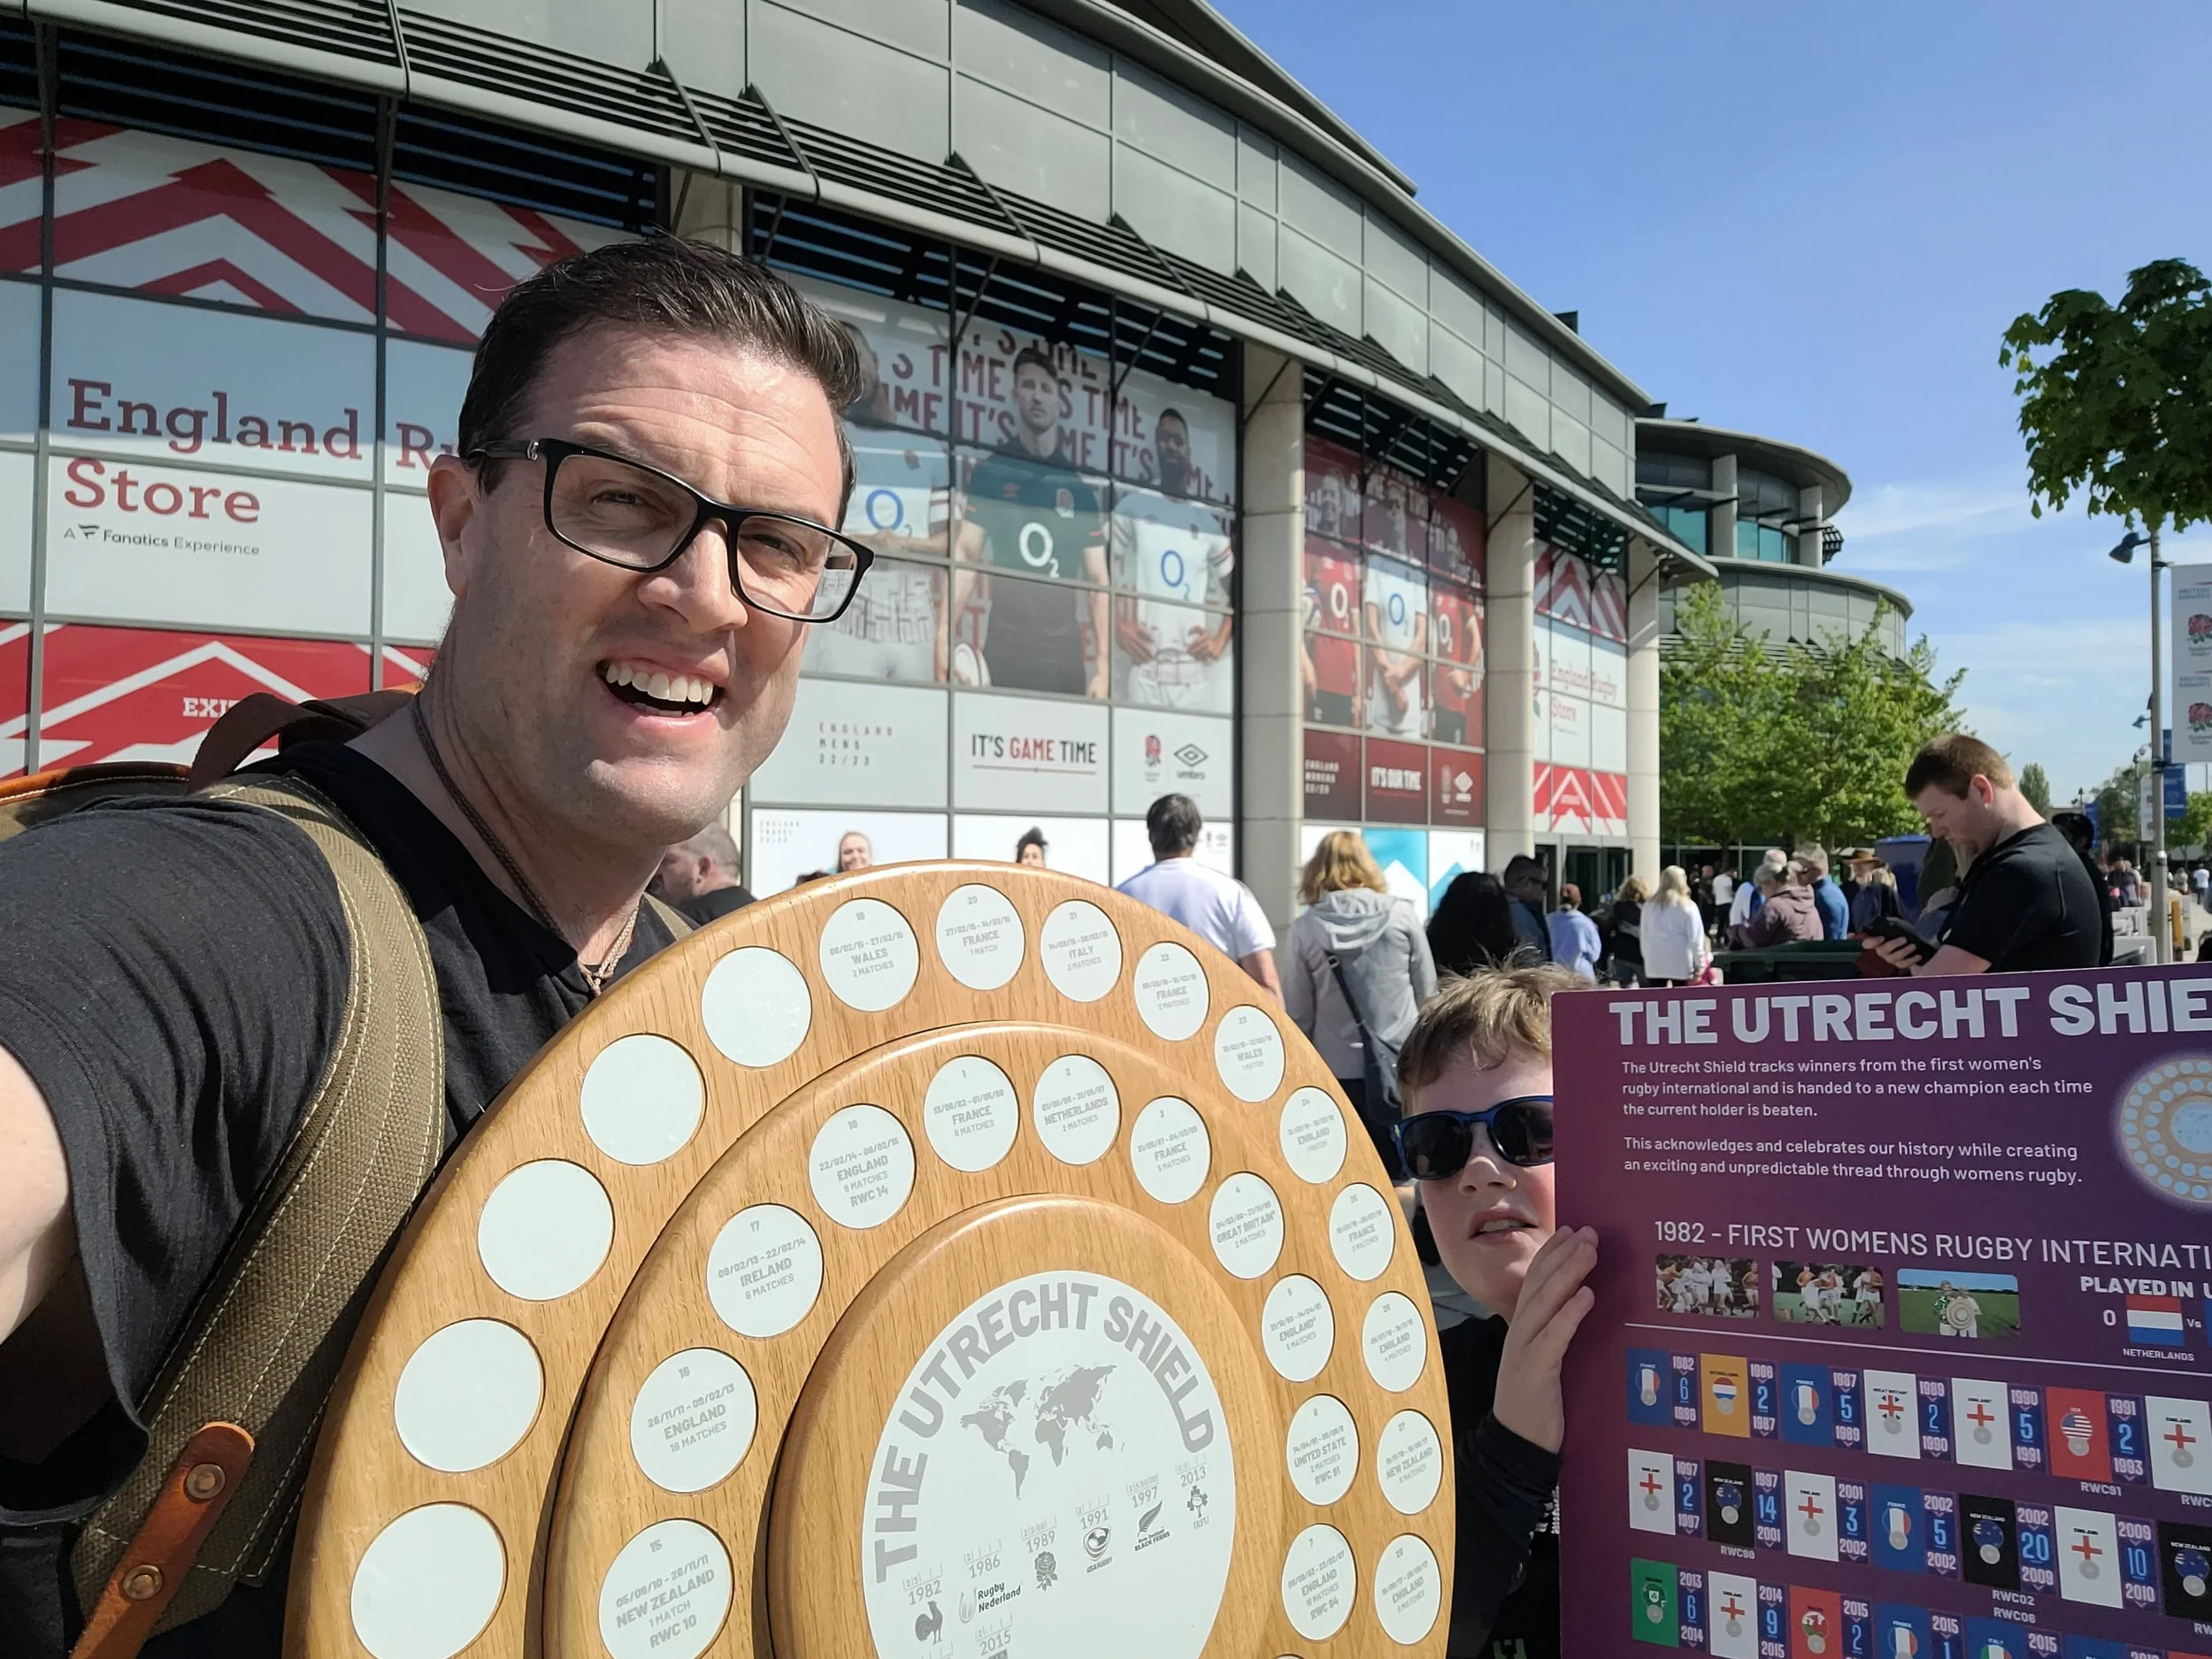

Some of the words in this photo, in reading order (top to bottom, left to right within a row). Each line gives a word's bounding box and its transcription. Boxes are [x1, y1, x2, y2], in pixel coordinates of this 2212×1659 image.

[66, 378, 364, 460] England
[65, 457, 261, 523] Store
[63, 528, 76, 540] A
[103, 529, 169, 548] Fanatics
[173, 536, 260, 556] Experience
[1018, 522, 1060, 579] O2
[972, 733, 1005, 759] IT'S
[1010, 736, 1056, 762] GAME
[1060, 739, 1098, 765] TIME
[963, 930, 1000, 947] FRANCE
[851, 948, 889, 965] WALES
[1068, 944, 1094, 960] ITALY
[1156, 986, 1188, 1001] FRANCE
[1609, 998, 1718, 1045] THE
[1731, 987, 2030, 1044] UTRECHT
[1622, 1062, 1647, 1073] The
[1649, 1061, 1701, 1073] Utrecht
[1702, 1061, 1747, 1073] Shield
[1749, 1060, 1794, 1073] tracks
[1798, 1059, 1856, 1072] winners
[1860, 1058, 1897, 1071] from
[1901, 1058, 1926, 1071] the
[1930, 1057, 1964, 1071] first
[1968, 1056, 2042, 1071] women's
[1623, 1082, 1659, 1097] rugby
[1662, 1081, 1749, 1094] international
[1752, 1081, 1778, 1094] and
[1782, 1081, 1794, 1094] is
[1798, 1081, 1853, 1094] handed
[1855, 1081, 1872, 1094] to
[1875, 1084, 1885, 1094] a
[1888, 1084, 1920, 1094] new
[1924, 1080, 2005, 1097] champion
[2008, 1079, 2050, 1094] each
[2054, 1079, 2093, 1094] time
[952, 1105, 992, 1125] FRANCE
[1044, 1096, 1109, 1125] NETHERLANDS
[1623, 1103, 1645, 1116] the
[1647, 1103, 1697, 1116] current
[1700, 1102, 1745, 1116] holder
[1747, 1103, 1760, 1117] is
[1763, 1103, 1818, 1117] beaten.
[1154, 1141, 1188, 1162] FRANCE
[1624, 1136, 1652, 1150] This
[1654, 1137, 1753, 1154] acknowledges
[1755, 1140, 1783, 1152] and
[1786, 1140, 1866, 1154] celebrates
[1869, 1143, 1895, 1155] our
[1898, 1141, 1955, 1159] history
[1958, 1142, 2002, 1157] while
[2006, 1143, 2078, 1161] creating
[836, 1155, 889, 1181] ENGLAND
[1624, 1160, 1640, 1171] an
[1643, 1159, 1697, 1176] exciting
[1700, 1160, 1725, 1173] and
[1728, 1161, 1830, 1177] unpredictable
[1832, 1164, 1883, 1178] thread
[1886, 1164, 1950, 1182] through
[1953, 1169, 2024, 1182] womens
[2028, 1168, 2084, 1186] rugby.
[850, 1171, 888, 1191] MATCHES
[849, 1190, 876, 1208] RWC
[749, 1220, 761, 1233] 17
[1655, 1220, 1705, 1244] 1982
[1728, 1224, 1800, 1248] FIRST
[1805, 1226, 1929, 1256] WOMENS
[1935, 1233, 2033, 1262] RUGBY
[739, 1257, 793, 1287] IRELAND
[752, 1272, 795, 1298] MATCHES
[2080, 1275, 2170, 1297] PLAYED
[2171, 1280, 2194, 1299] IN
[2186, 1317, 2202, 1329] Vs
[1379, 1332, 1411, 1355] ENGLAND
[2123, 1347, 2195, 1363] NETHERLANDS
[898, 1281, 1099, 1440] UTRECHT
[1103, 1295, 1215, 1454] SHIELD
[1757, 1386, 1769, 1410] 2
[1839, 1394, 1853, 1420] 5
[663, 1403, 726, 1440] ENGLAND
[1928, 1404, 1939, 1430] 2
[2019, 1413, 2034, 1440] 5
[681, 1420, 727, 1449] MATCHES
[2118, 1424, 2134, 1451] 2
[1180, 1465, 1207, 1487] 2013
[1755, 1471, 1778, 1488] 1997
[1132, 1486, 1158, 1509] 1997
[1682, 1483, 1694, 1508] 2
[1839, 1482, 1863, 1501] 2001
[2080, 1481, 2123, 1497] RWC91
[874, 1444, 929, 1584] THE
[1758, 1494, 1778, 1521] 14
[1924, 1494, 1954, 1513] 2002
[1080, 1508, 1109, 1530] 1991
[1194, 1516, 1210, 1530] IRFU
[1846, 1507, 1858, 1532] 3
[2016, 1507, 2049, 1526] 2002
[1026, 1530, 1056, 1554] 1989
[1757, 1525, 1781, 1542] 2001
[1933, 1519, 1947, 1546] 5
[2117, 1520, 2152, 1541] 2009
[649, 1539, 663, 1553] 15
[1134, 1539, 1153, 1551] BLACK
[1839, 1538, 1868, 1556] 2002
[2021, 1532, 2049, 1562] 20
[969, 1554, 1001, 1578] 1986
[1927, 1551, 1957, 1571] 2002
[2128, 1548, 2147, 1577] 10
[1301, 1568, 1338, 1597] ENGLAND
[1680, 1571, 1702, 1589] 2013
[2022, 1566, 2054, 1586] 2009
[616, 1578, 664, 1609] 05/09/10
[616, 1601, 649, 1629] NEW
[649, 1568, 715, 1611] ZEALAND
[908, 1579, 942, 1606] 1982
[978, 1582, 1005, 1601] Rugby
[979, 1585, 1021, 1613] Nederland
[1759, 1585, 1783, 1602] 2014
[2125, 1583, 2156, 1602] 2010
[655, 1600, 691, 1626] MATCH
[1686, 1595, 1697, 1621] 6
[1843, 1600, 1869, 1618] 2015
[649, 1621, 681, 1649] RWC
[681, 1614, 697, 1631] 10
[1681, 1625, 1704, 1642] 2014
[1766, 1609, 1778, 1635] 9
[1932, 1615, 1960, 1635] 2015
[979, 1628, 1012, 1656] 2015
[1761, 1640, 1785, 1658] 2015
[1852, 1624, 1863, 1651] 2
